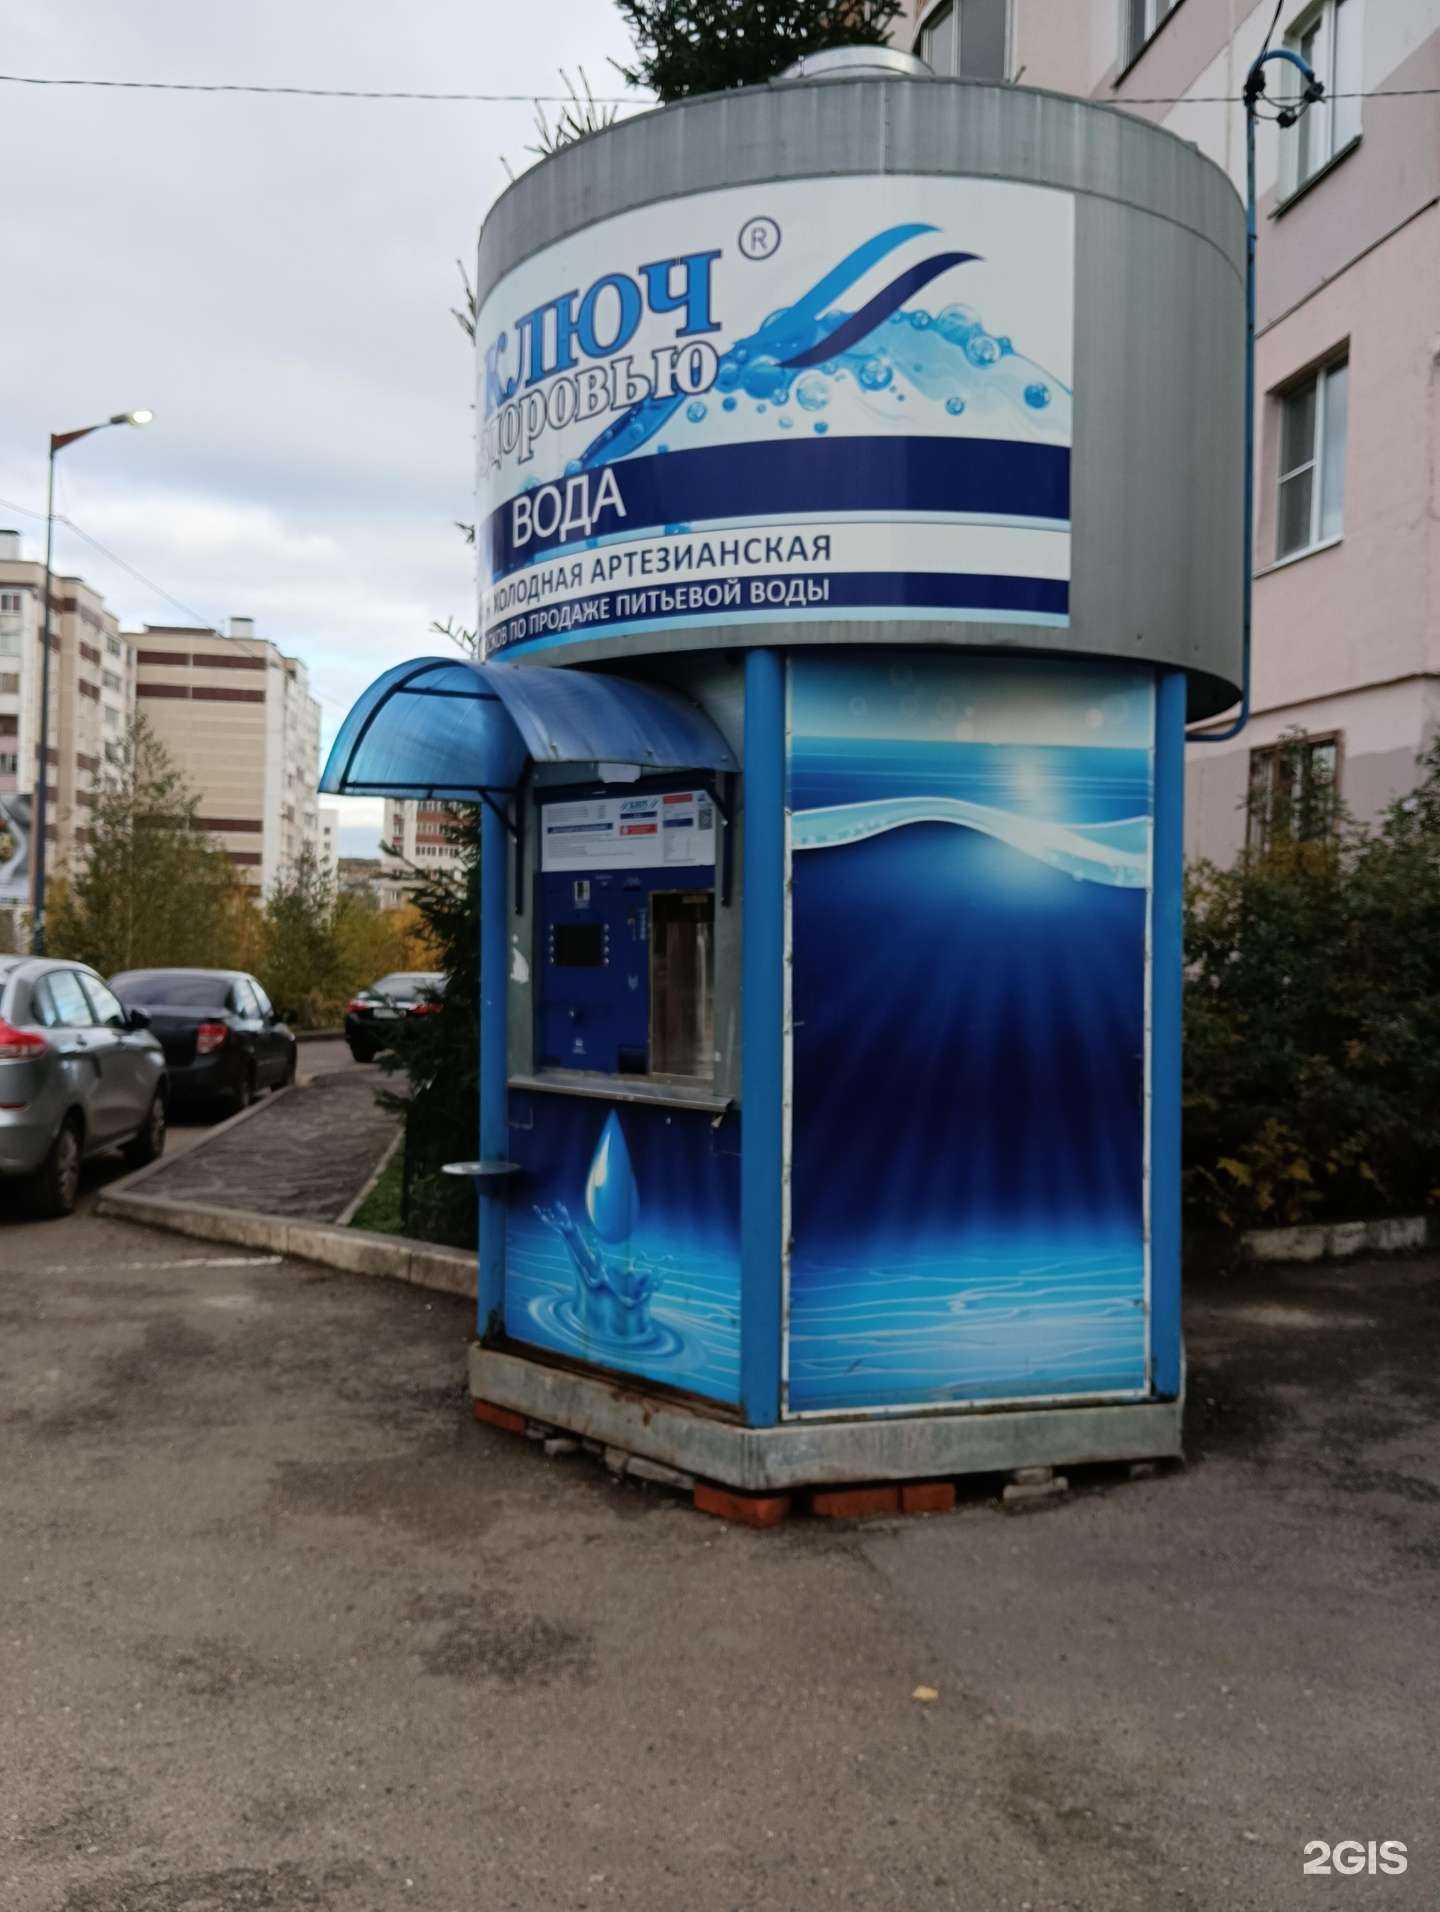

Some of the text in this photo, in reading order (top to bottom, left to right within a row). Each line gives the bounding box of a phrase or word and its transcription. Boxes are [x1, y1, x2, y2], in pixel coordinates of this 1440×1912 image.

[512, 468, 626, 548] ВОДА
[590, 534, 832, 584] АРТЕЗИАНСКАЯ
[510, 618, 527, 641] ПО
[529, 598, 610, 634] ПРОДАЖЕ
[616, 578, 741, 617] ПИТЬЕВОЙ
[750, 578, 831, 607] ВОДЫ
